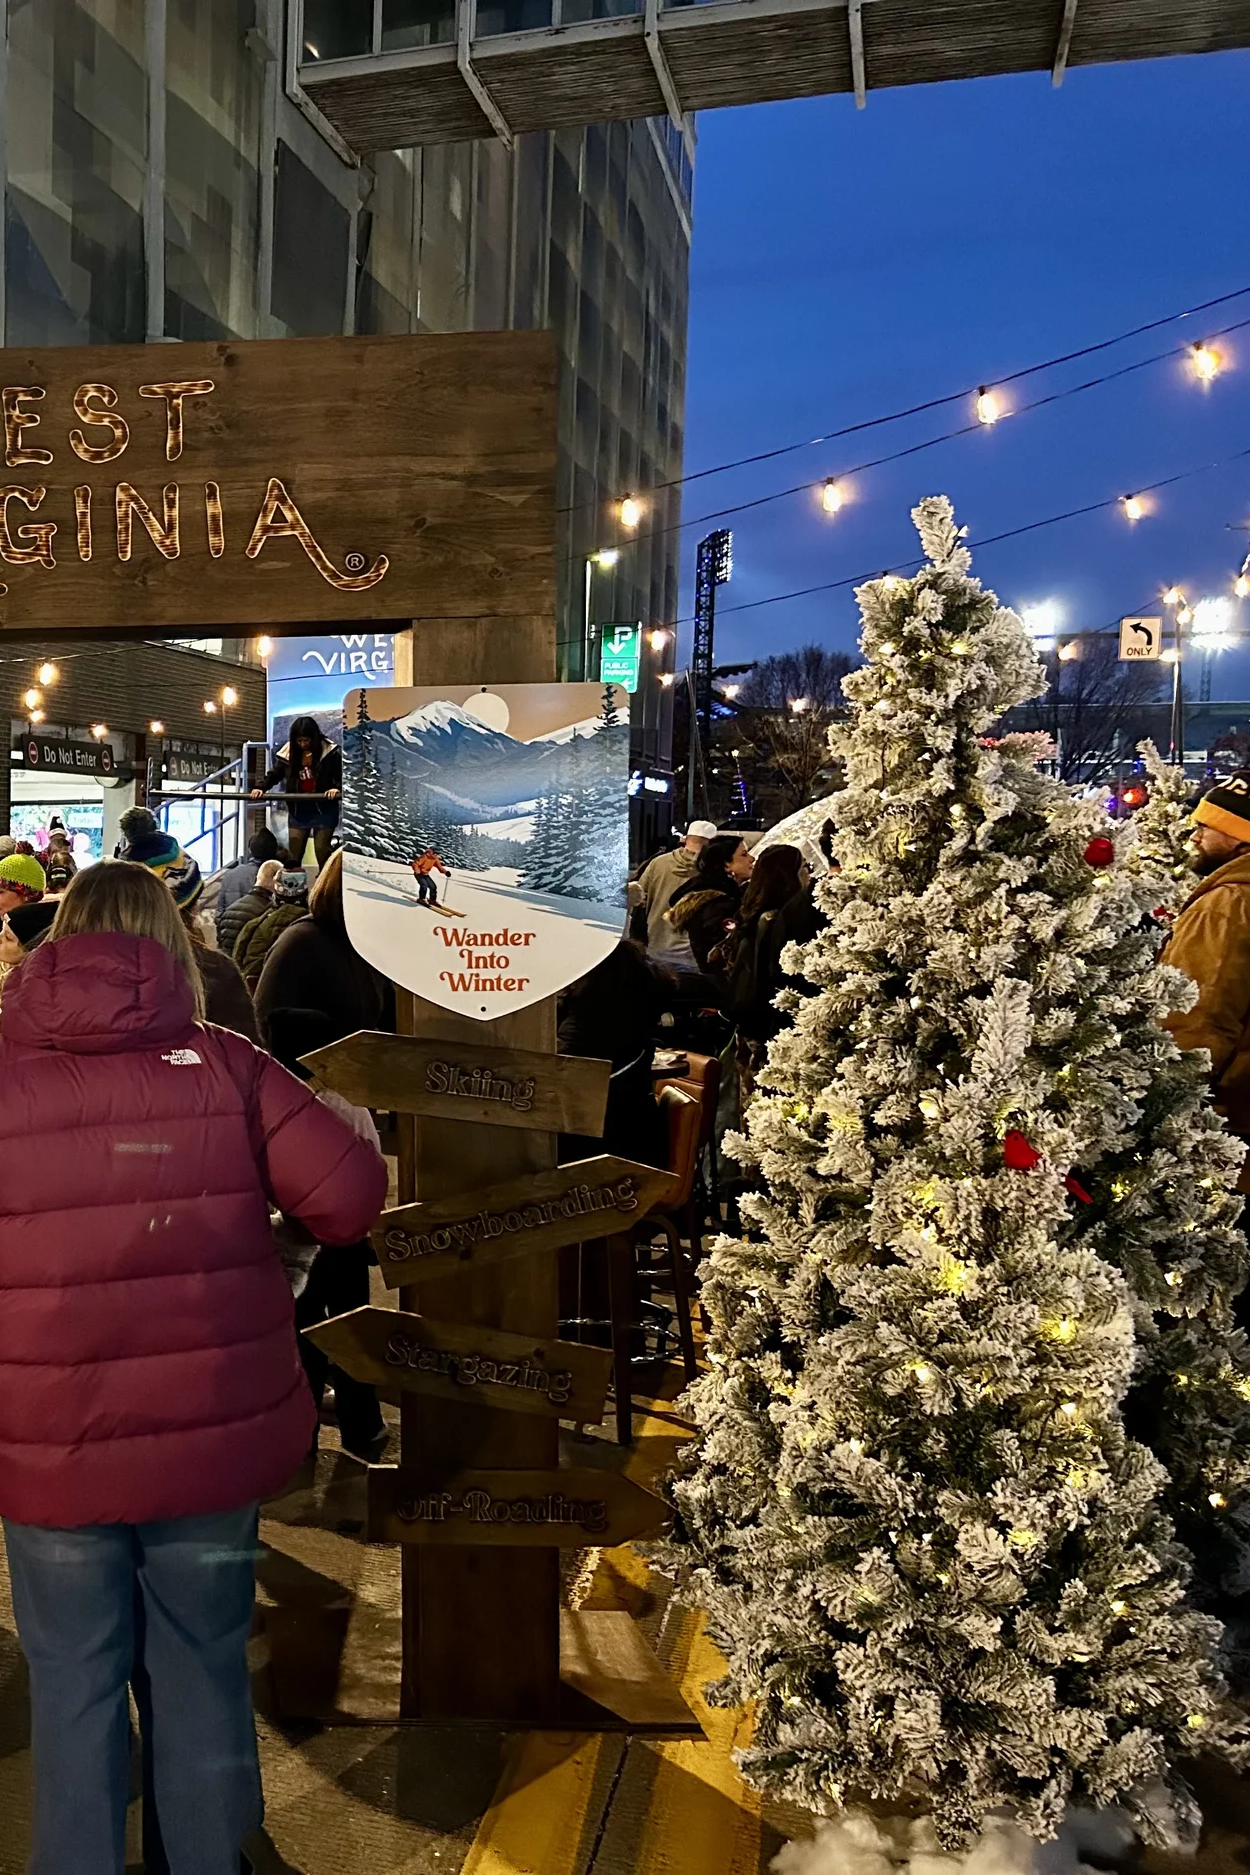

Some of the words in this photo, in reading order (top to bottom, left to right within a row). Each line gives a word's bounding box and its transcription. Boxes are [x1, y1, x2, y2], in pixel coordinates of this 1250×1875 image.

[330, 634, 394, 649] WE
[1126, 647, 1152, 656] ONLY
[302, 651, 394, 680] VIRG
[44, 746, 56, 762] Do
[58, 748, 74, 765] Not
[75, 751, 97, 767] Enter
[180, 760, 190, 774] Do
[191, 760, 203, 775] Not
[433, 926, 536, 947] Wander
[459, 948, 510, 969] Into
[439, 971, 530, 992] Winter
[424, 1060, 535, 1111] Skiing
[385, 1177, 638, 1262] Snowboarding
[384, 1335, 572, 1402] Stargazing
[397, 1489, 607, 1532] Off-Roading
